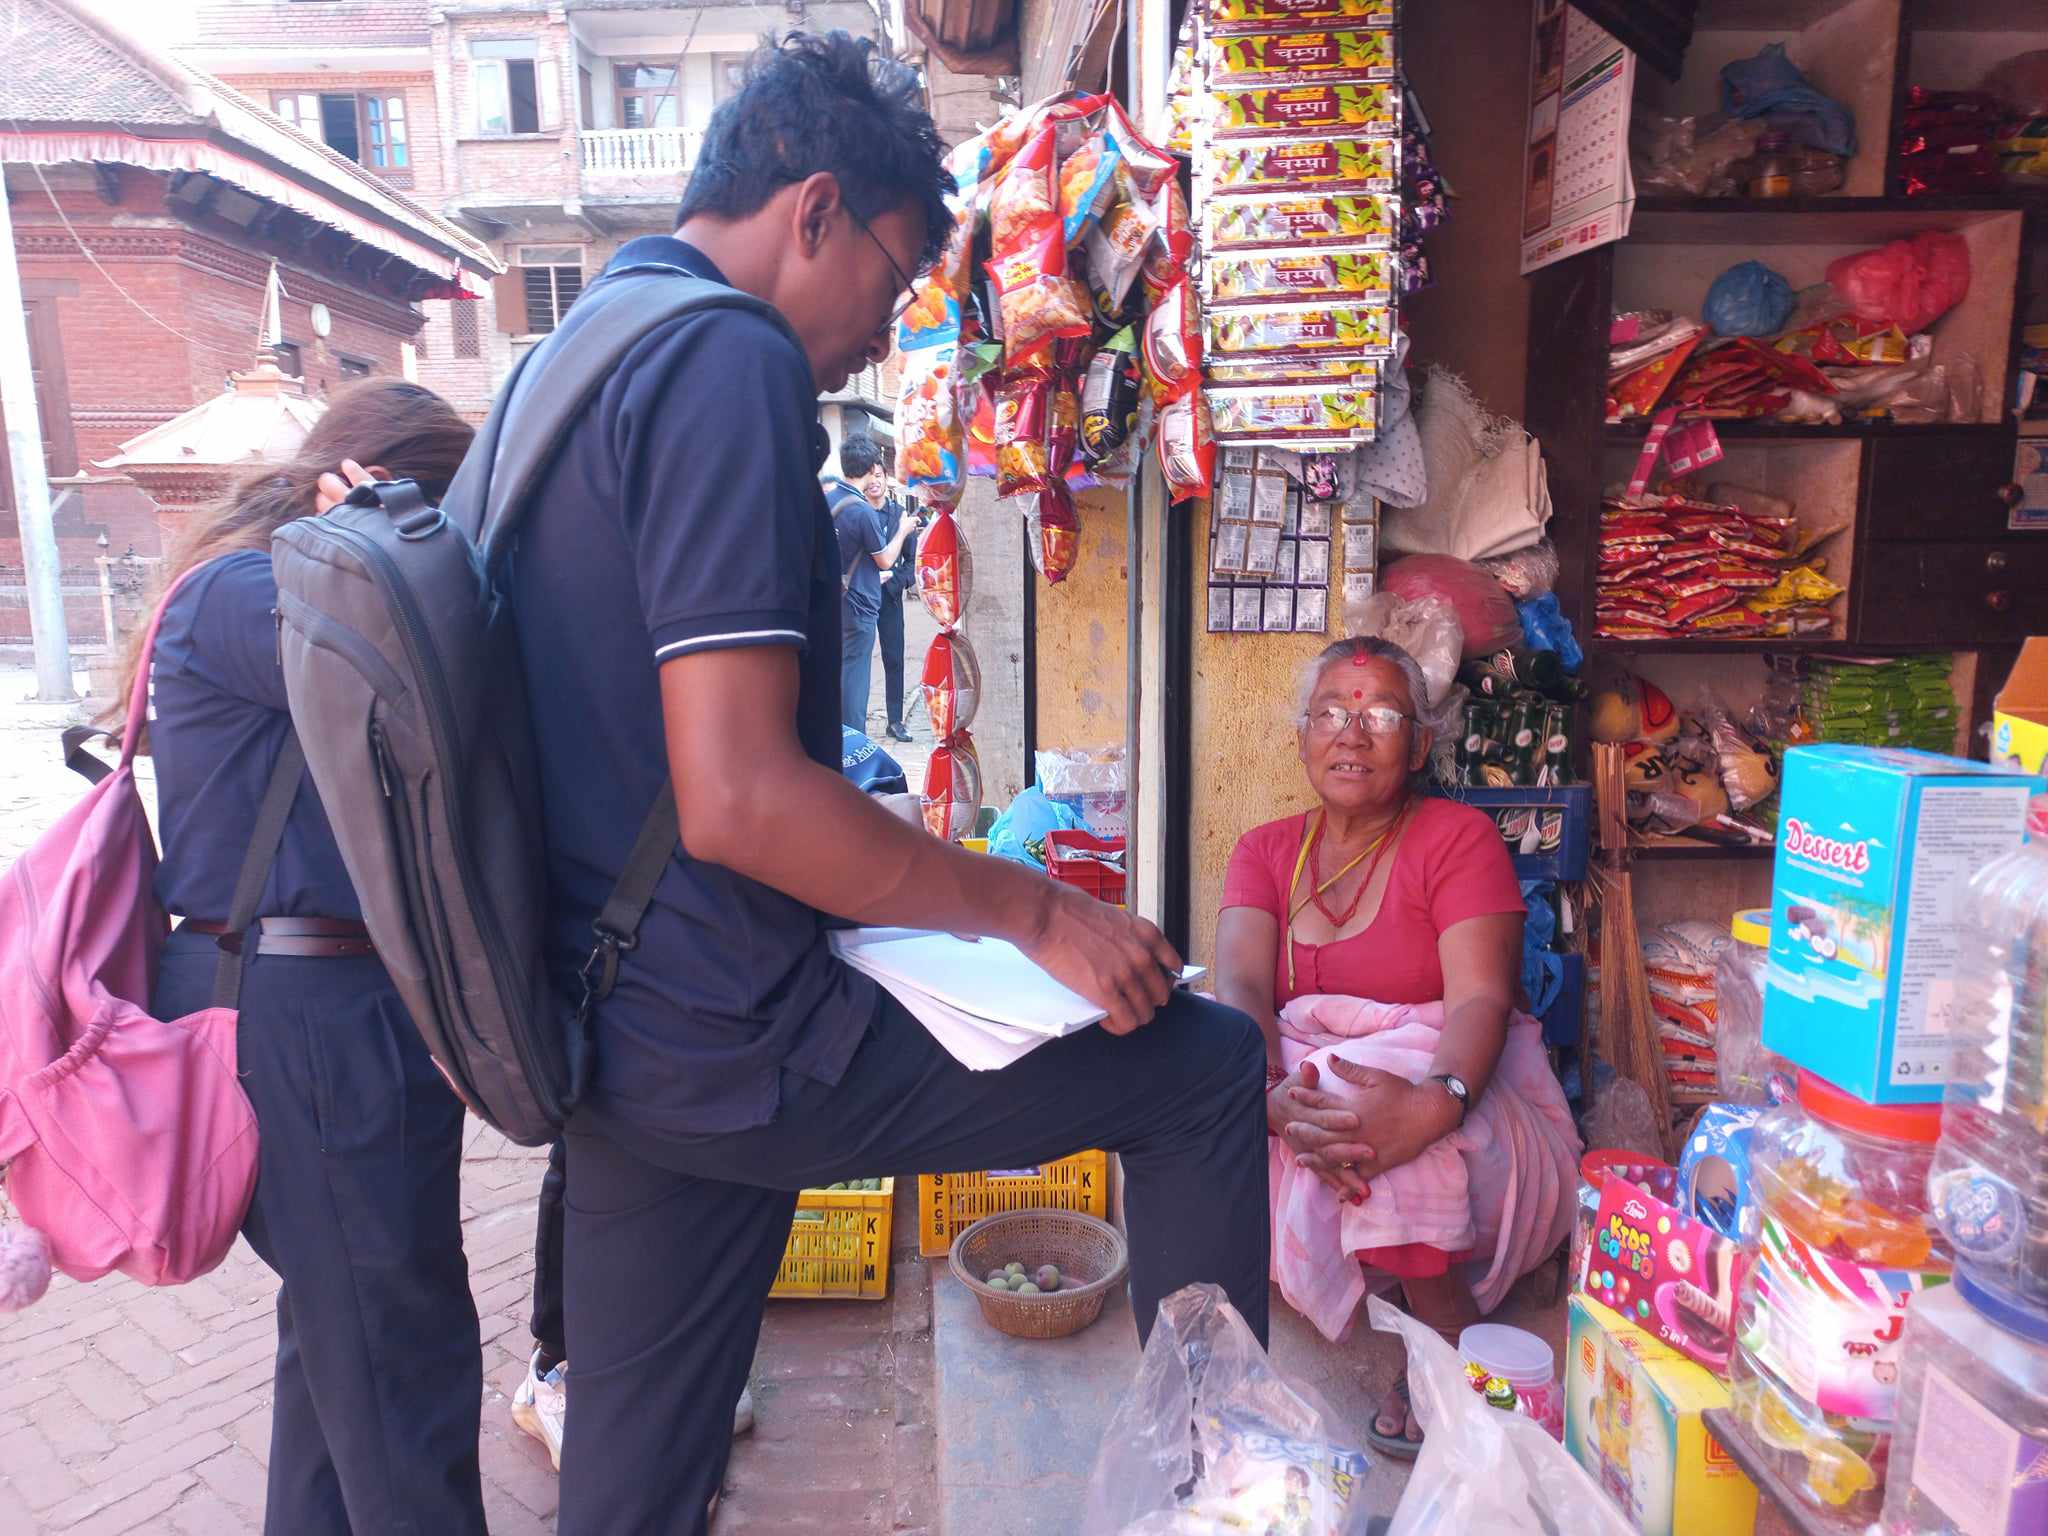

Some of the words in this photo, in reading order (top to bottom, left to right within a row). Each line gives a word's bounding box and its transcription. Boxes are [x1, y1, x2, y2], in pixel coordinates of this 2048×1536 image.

[1273, 47, 1331, 59] चम्पा
[1273, 101, 1331, 113] चम्पा
[1272, 157, 1329, 170] चम्पा
[1785, 819, 1869, 873] Dessert
[1082, 1172, 1092, 1211] KT
[1599, 1228, 1654, 1280] COMBO
[1610, 1214, 1650, 1255] KIDS
